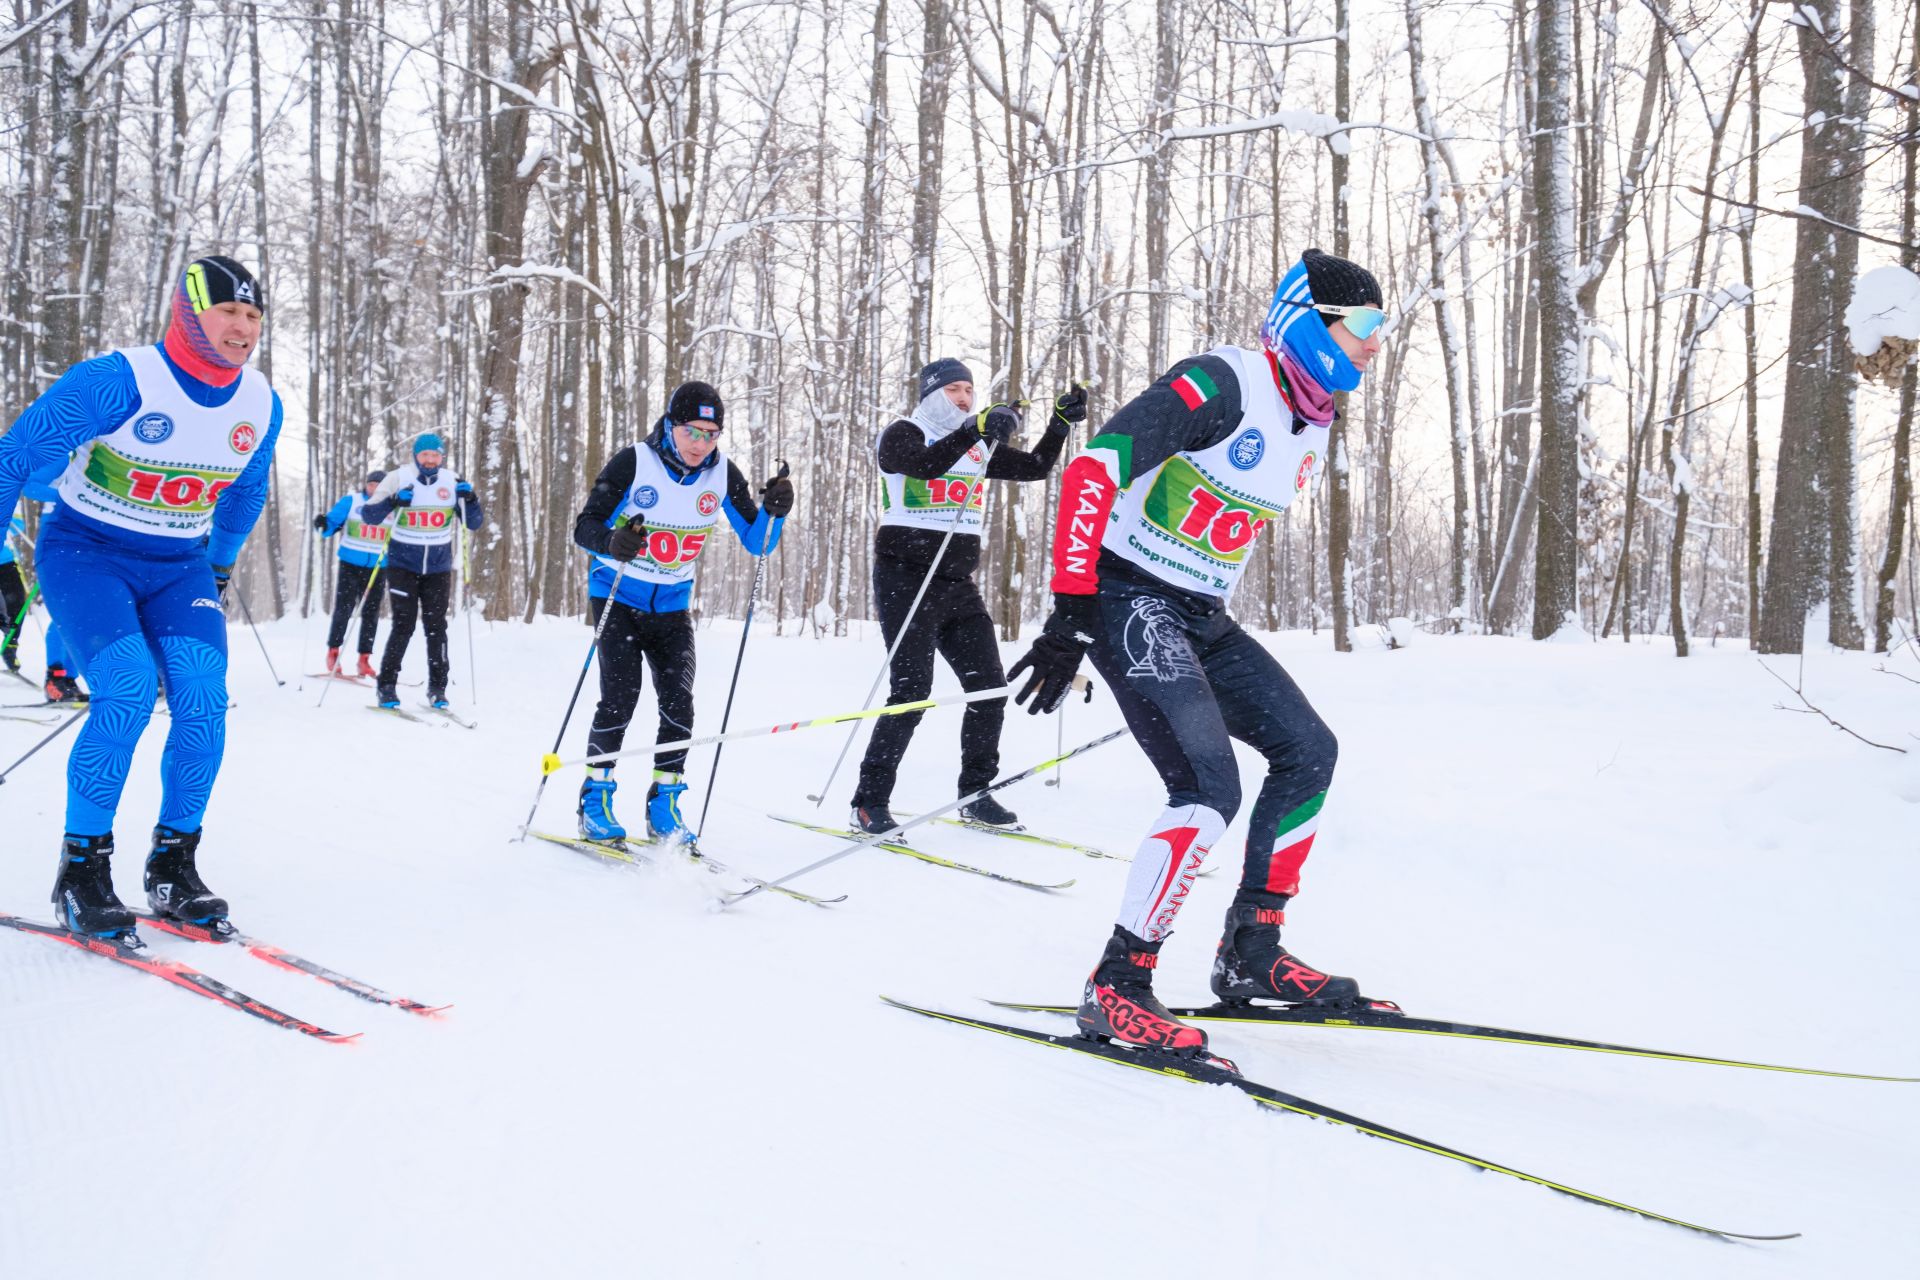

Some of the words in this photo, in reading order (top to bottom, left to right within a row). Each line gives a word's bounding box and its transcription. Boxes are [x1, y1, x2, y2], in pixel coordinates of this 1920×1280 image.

[360, 524, 386, 541] 111
[406, 511, 446, 528] 110
[1065, 478, 1104, 574] KAZAN
[1177, 485, 1268, 554] 10
[636, 530, 707, 564] 05
[1128, 534, 1209, 582] Спортивная
[1099, 993, 1183, 1047] ROSSI
